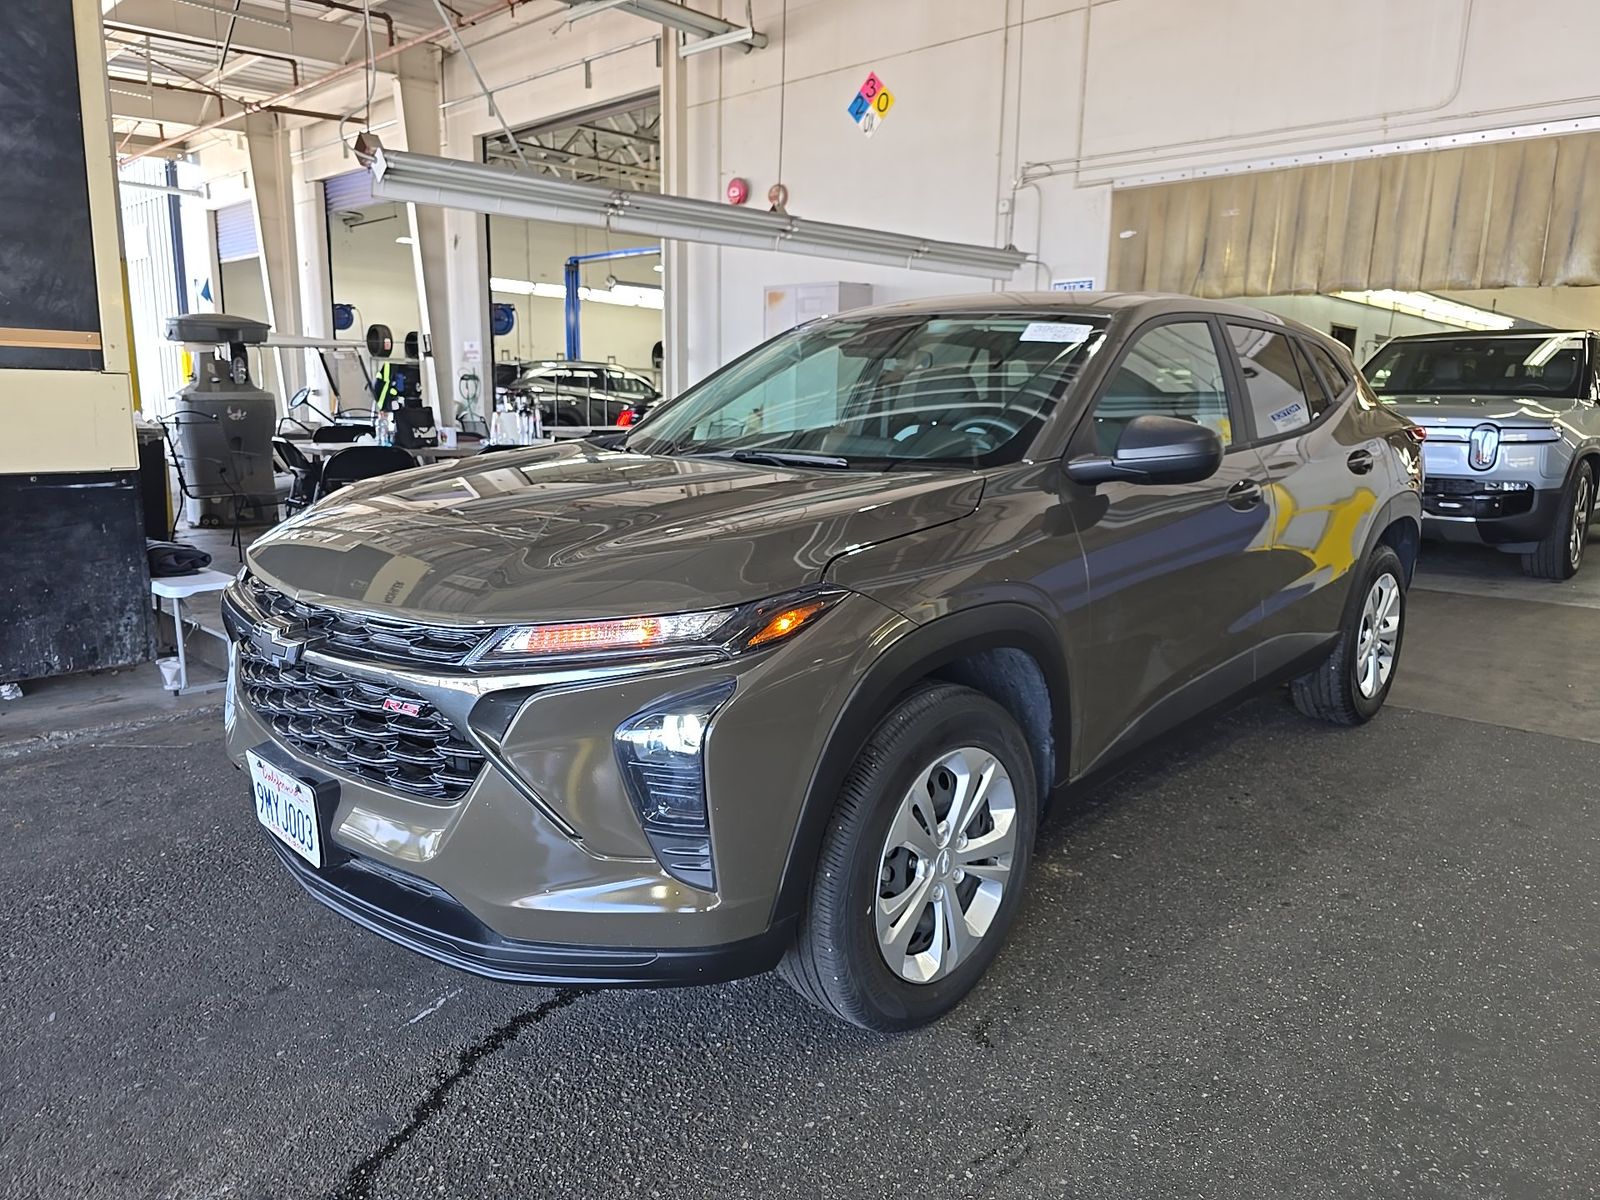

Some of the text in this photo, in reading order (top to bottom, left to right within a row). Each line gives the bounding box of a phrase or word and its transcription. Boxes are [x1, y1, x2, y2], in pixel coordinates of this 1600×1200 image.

[865, 78, 877, 98] 3
[855, 95, 865, 116] 2
[877, 92, 889, 113] 0
[382, 698, 421, 718] RS
[256, 781, 314, 852] 9MYJ003
